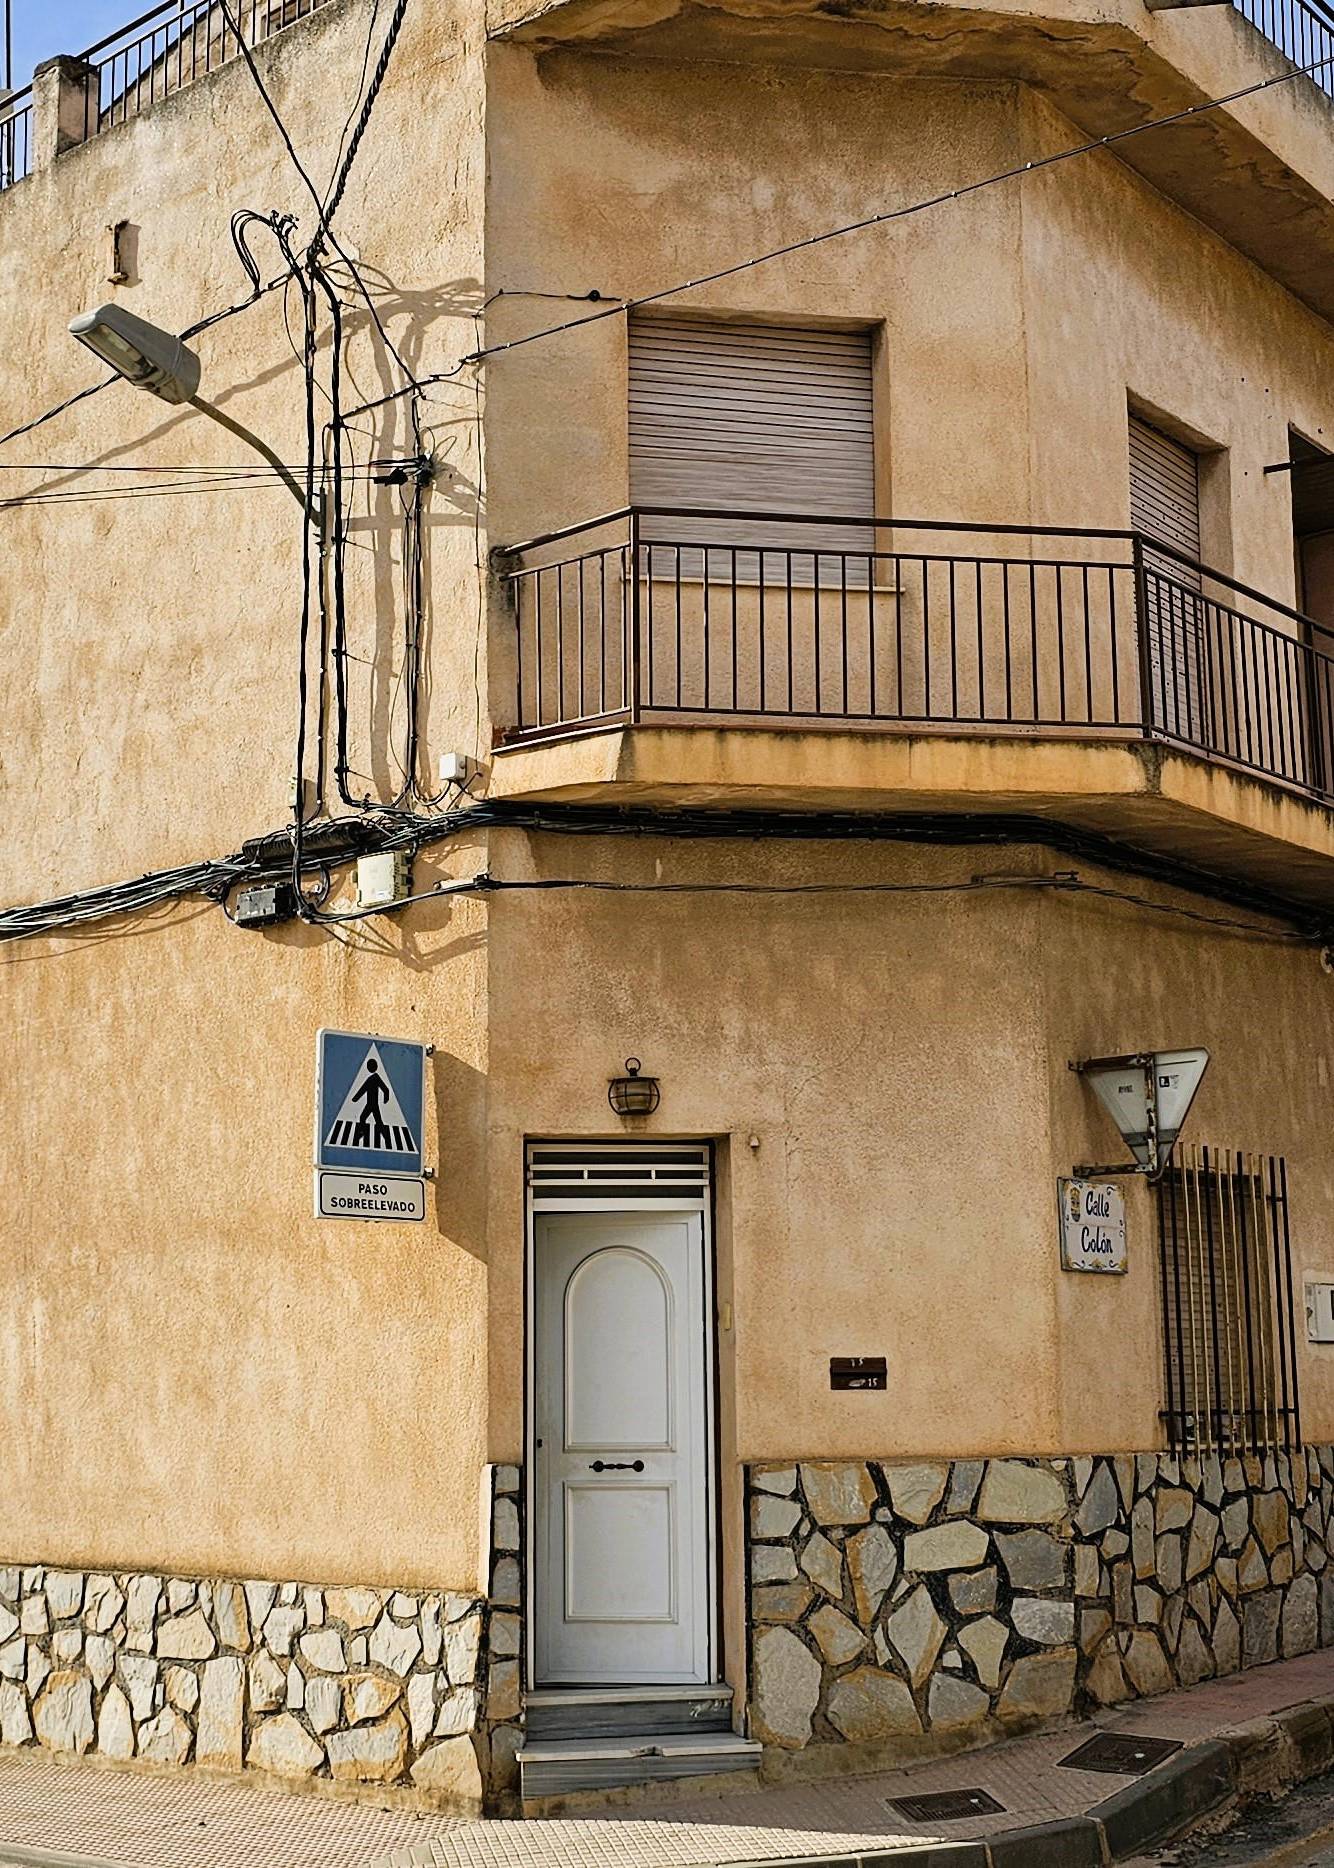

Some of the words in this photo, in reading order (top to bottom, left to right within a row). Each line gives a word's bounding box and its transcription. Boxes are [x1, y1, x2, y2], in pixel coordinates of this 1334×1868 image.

[358, 1183, 388, 1196] PASO
[330, 1196, 416, 1213] SOBREELEVADO
[1085, 1190, 1110, 1218] Calle
[1080, 1225, 1114, 1254] Colón
[867, 1377, 878, 1387] 15
